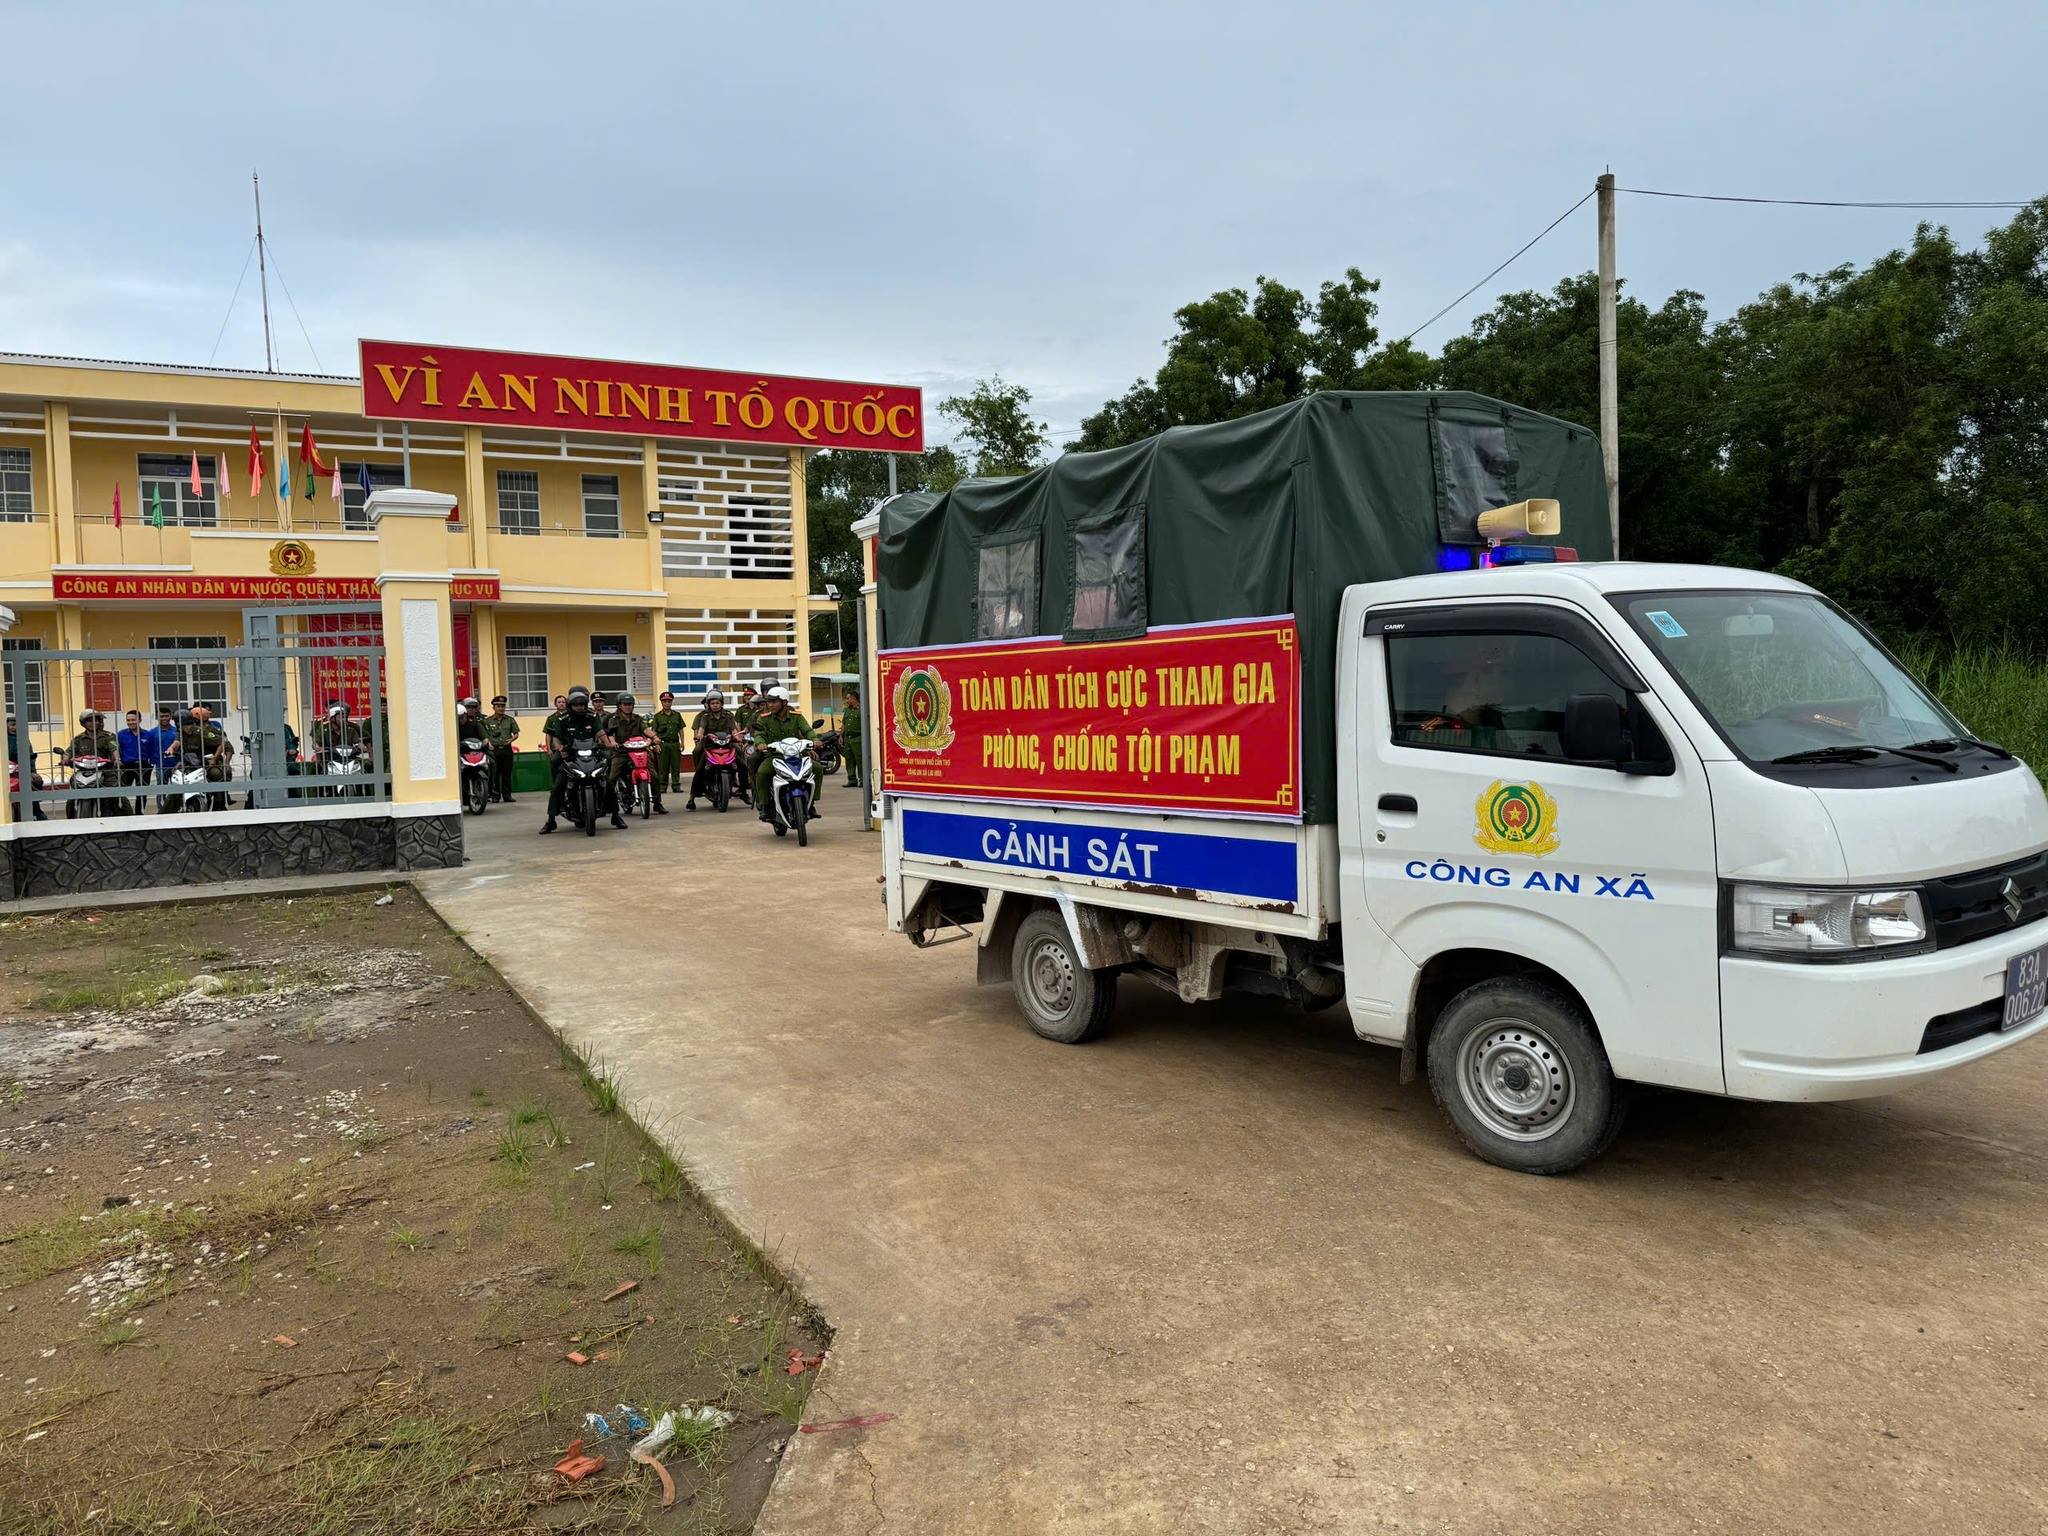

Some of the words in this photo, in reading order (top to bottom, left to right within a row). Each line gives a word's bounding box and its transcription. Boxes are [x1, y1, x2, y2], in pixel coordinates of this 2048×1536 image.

[374, 355, 443, 406] VÌ
[457, 371, 537, 413] AN
[552, 377, 693, 423] NINH
[705, 380, 774, 429] TỔ
[784, 390, 915, 440] QUỐC
[62, 577, 109, 594] CÔNG
[114, 581, 137, 594] AN
[142, 578, 187, 594] NHÂN
[191, 578, 225, 594] DÂN
[230, 578, 246, 594] VÌ
[250, 578, 292, 595] NƯỚC
[296, 579, 337, 596] QUÊN
[340, 579, 380, 595] THÂN
[475, 583, 494, 597] VỤ
[959, 670, 1006, 711] TOÀN
[1011, 668, 1049, 710] DÂN
[1056, 666, 1099, 709] TÍCH
[1106, 664, 1147, 716] CỰC
[1155, 666, 1223, 706] THAM
[1233, 662, 1275, 705] GIA
[983, 722, 1046, 775] PHÒNG,
[1053, 724, 1118, 772] CHỐNG
[1126, 727, 1161, 782] TỘI
[1170, 735, 1240, 784] PHẠM
[982, 822, 1070, 869] CẢNH
[1087, 832, 1159, 879] SÁT
[1405, 858, 1511, 888] CÔNG
[1522, 871, 1580, 894] AN
[1594, 872, 1655, 900] XÃ
[2018, 951, 2040, 988] 83A
[2005, 981, 2045, 1025] 006.22
